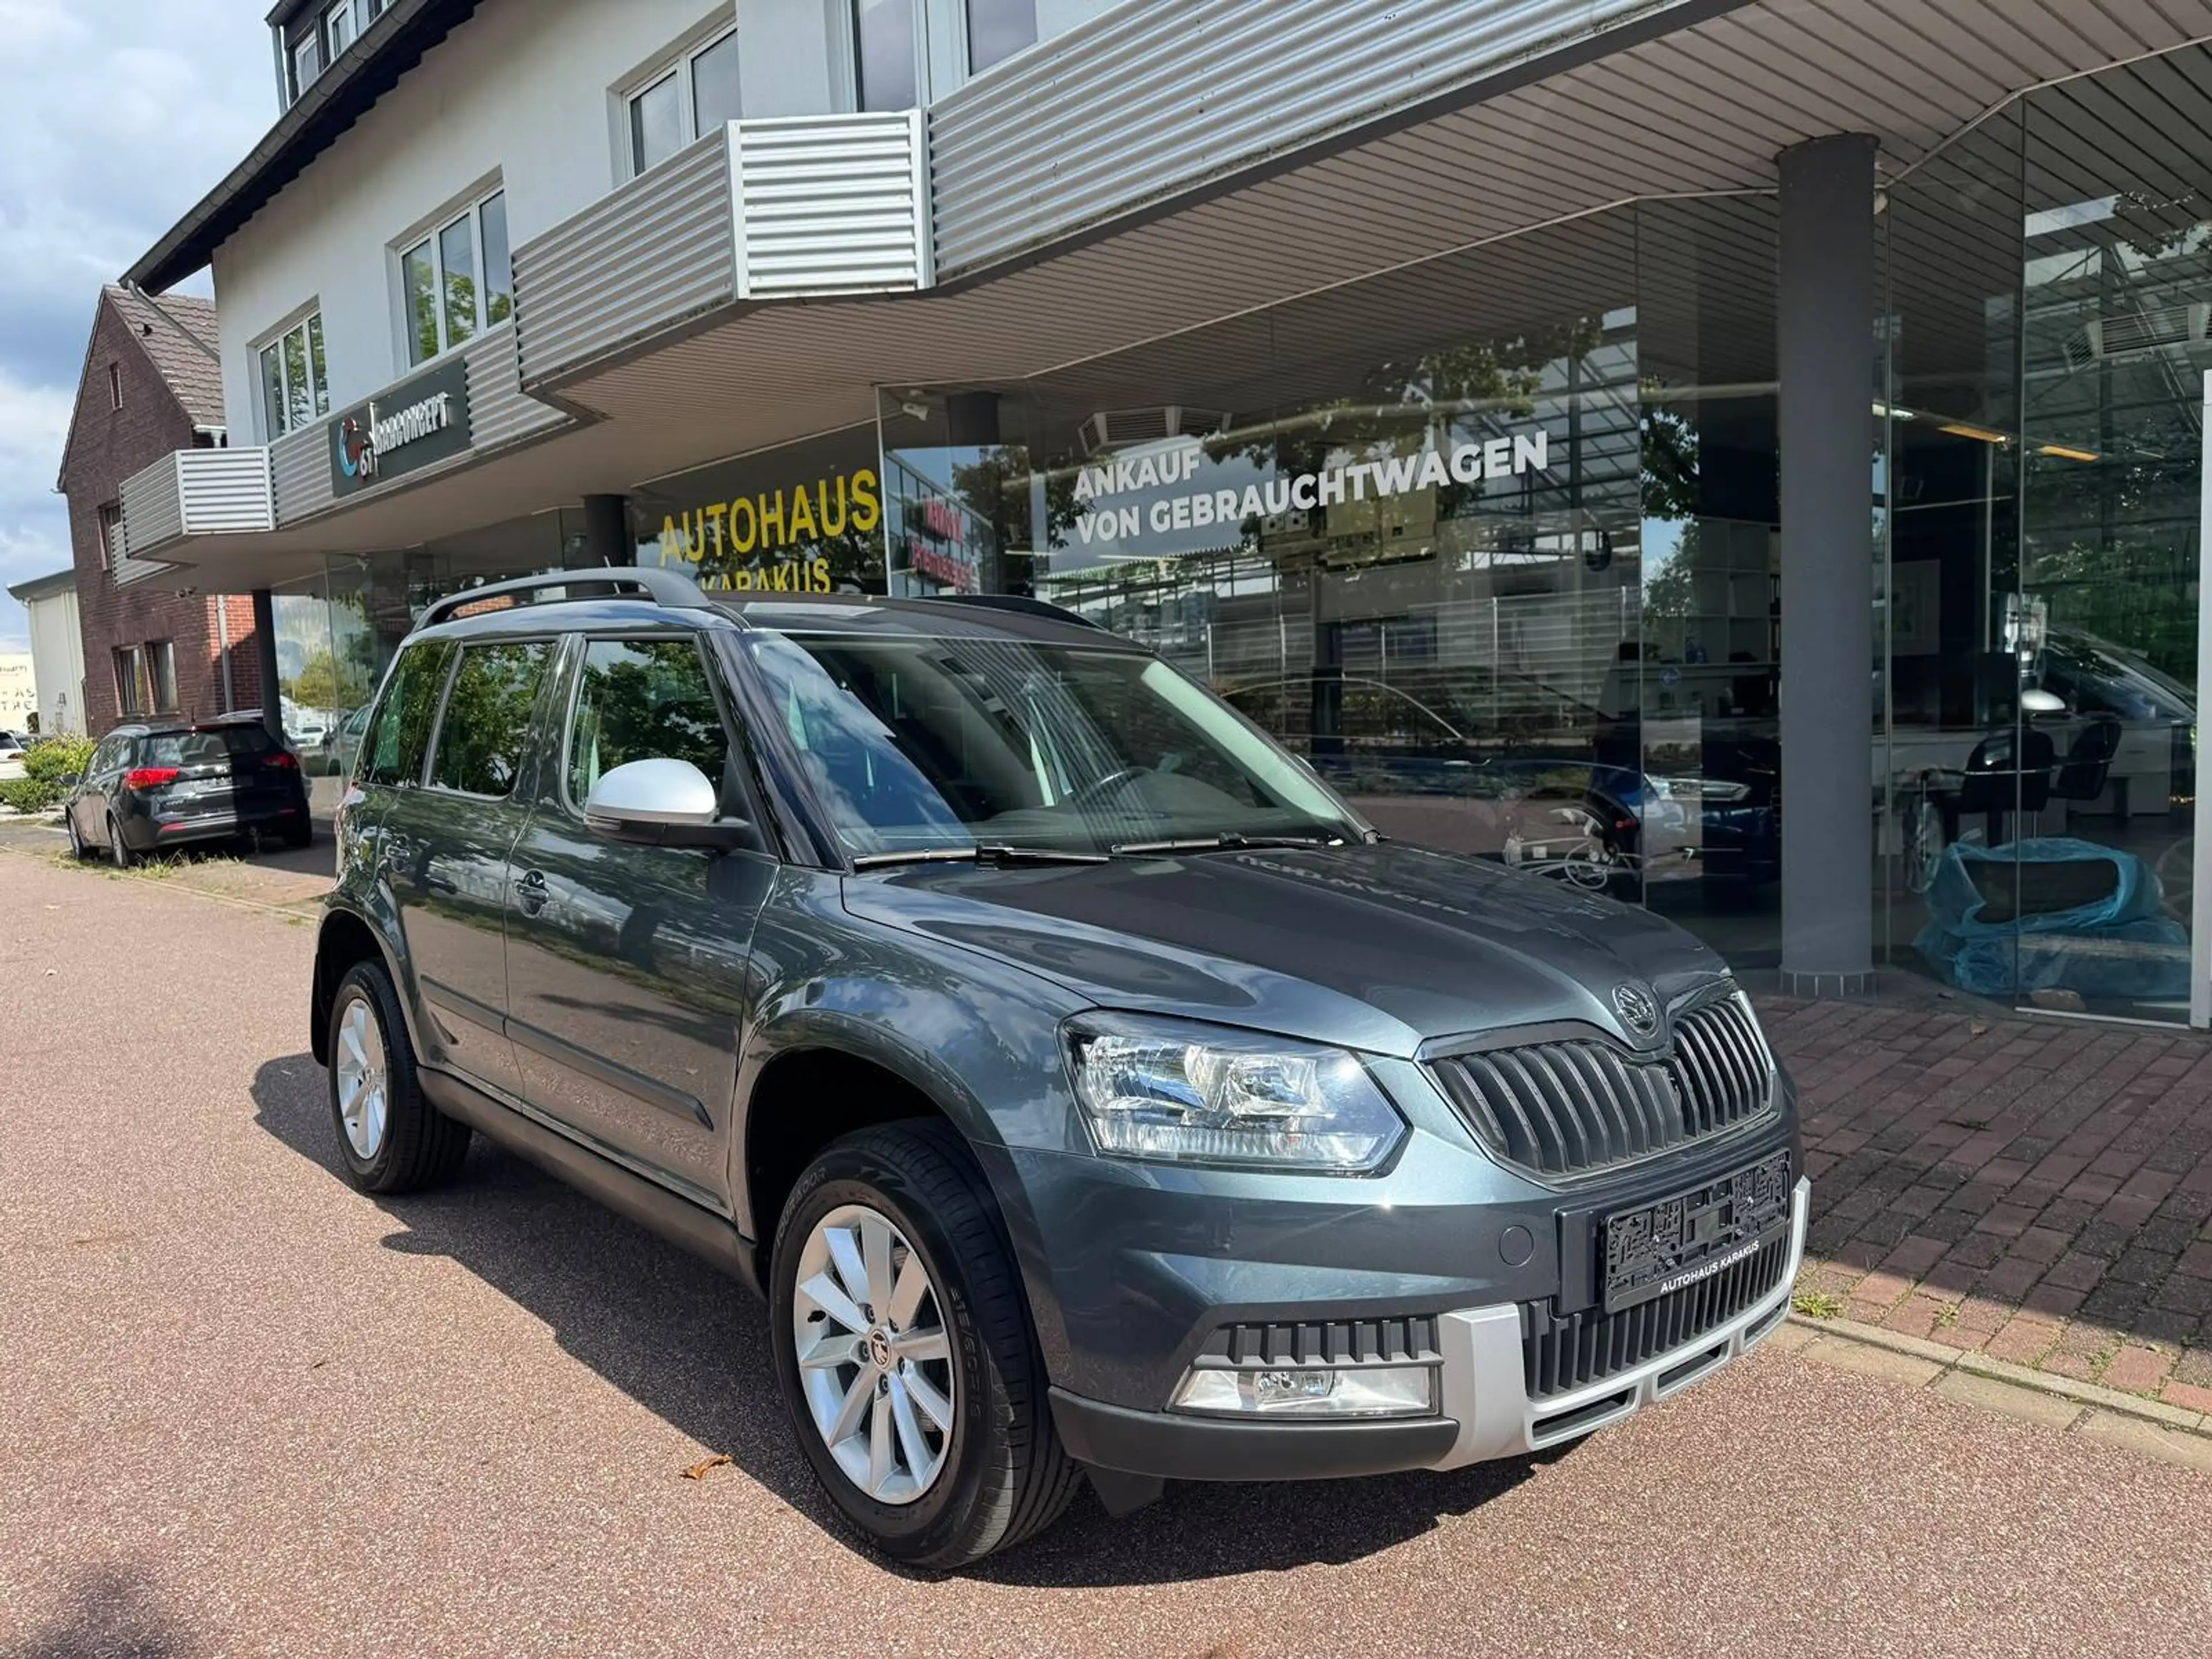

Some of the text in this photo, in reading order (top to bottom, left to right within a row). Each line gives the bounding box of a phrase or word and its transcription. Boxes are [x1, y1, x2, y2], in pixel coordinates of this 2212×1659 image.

[1073, 451, 1200, 501] ANKAUF
[1075, 430, 1550, 545] VON GEBRAUCHTWAGEN
[658, 469, 880, 567] AUTOHAUS
[1660, 1240, 1760, 1294] AUTOHAUS KARAKUS
